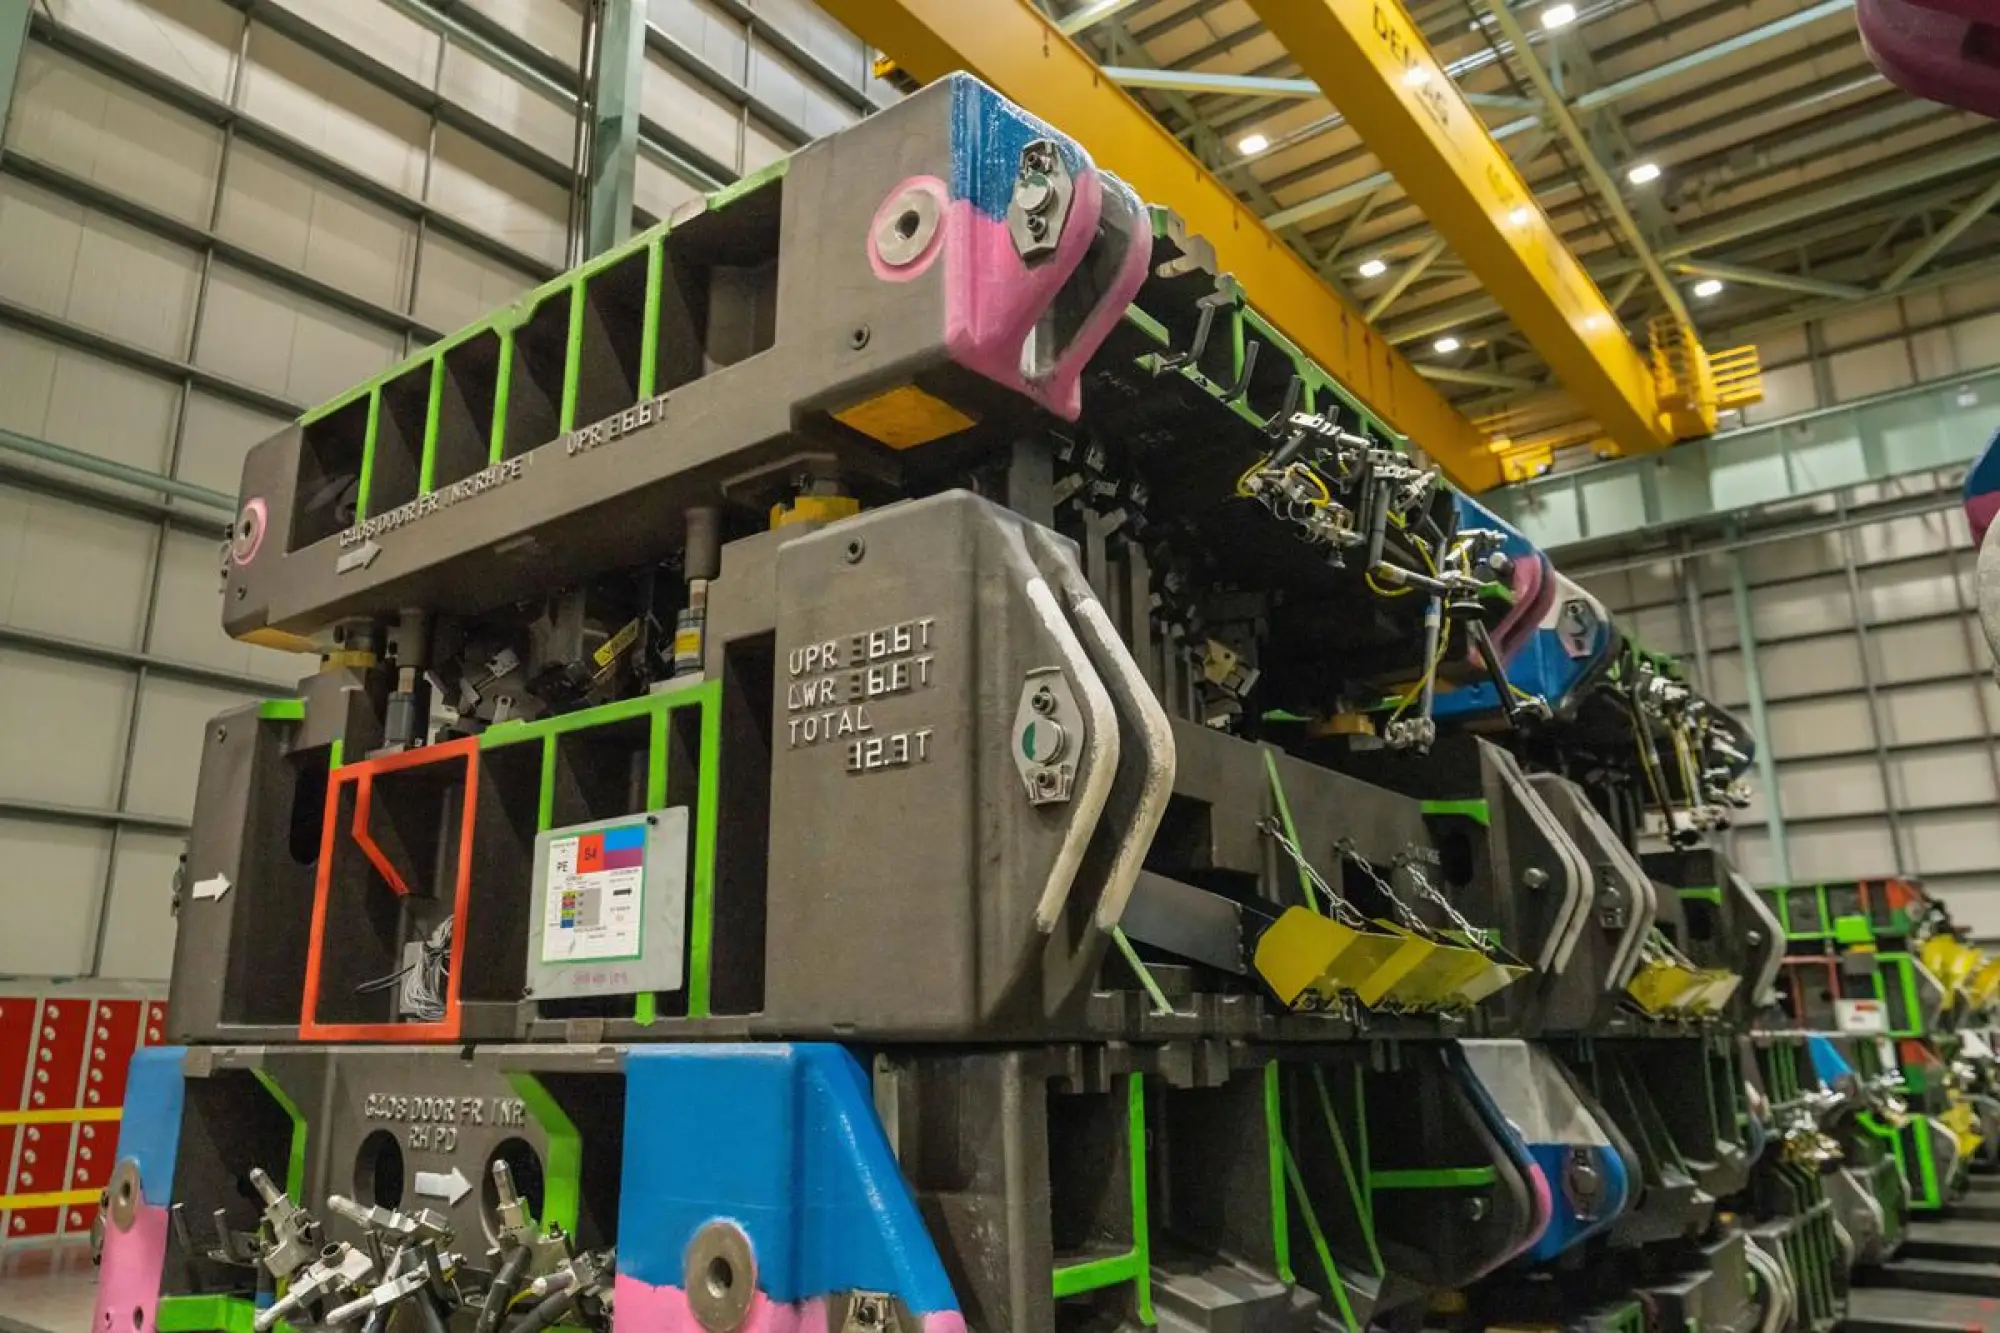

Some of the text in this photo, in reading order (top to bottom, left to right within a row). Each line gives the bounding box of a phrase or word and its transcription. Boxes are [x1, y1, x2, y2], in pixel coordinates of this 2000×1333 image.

[567, 424, 603, 454] UPR
[500, 456, 523, 480] PE
[789, 641, 838, 676] UPR
[788, 677, 837, 711] LWR
[787, 705, 873, 746] TOTAL
[410, 1096, 456, 1122] DOOR
[459, 1096, 485, 1124] FR
[409, 1125, 431, 1150] RH
